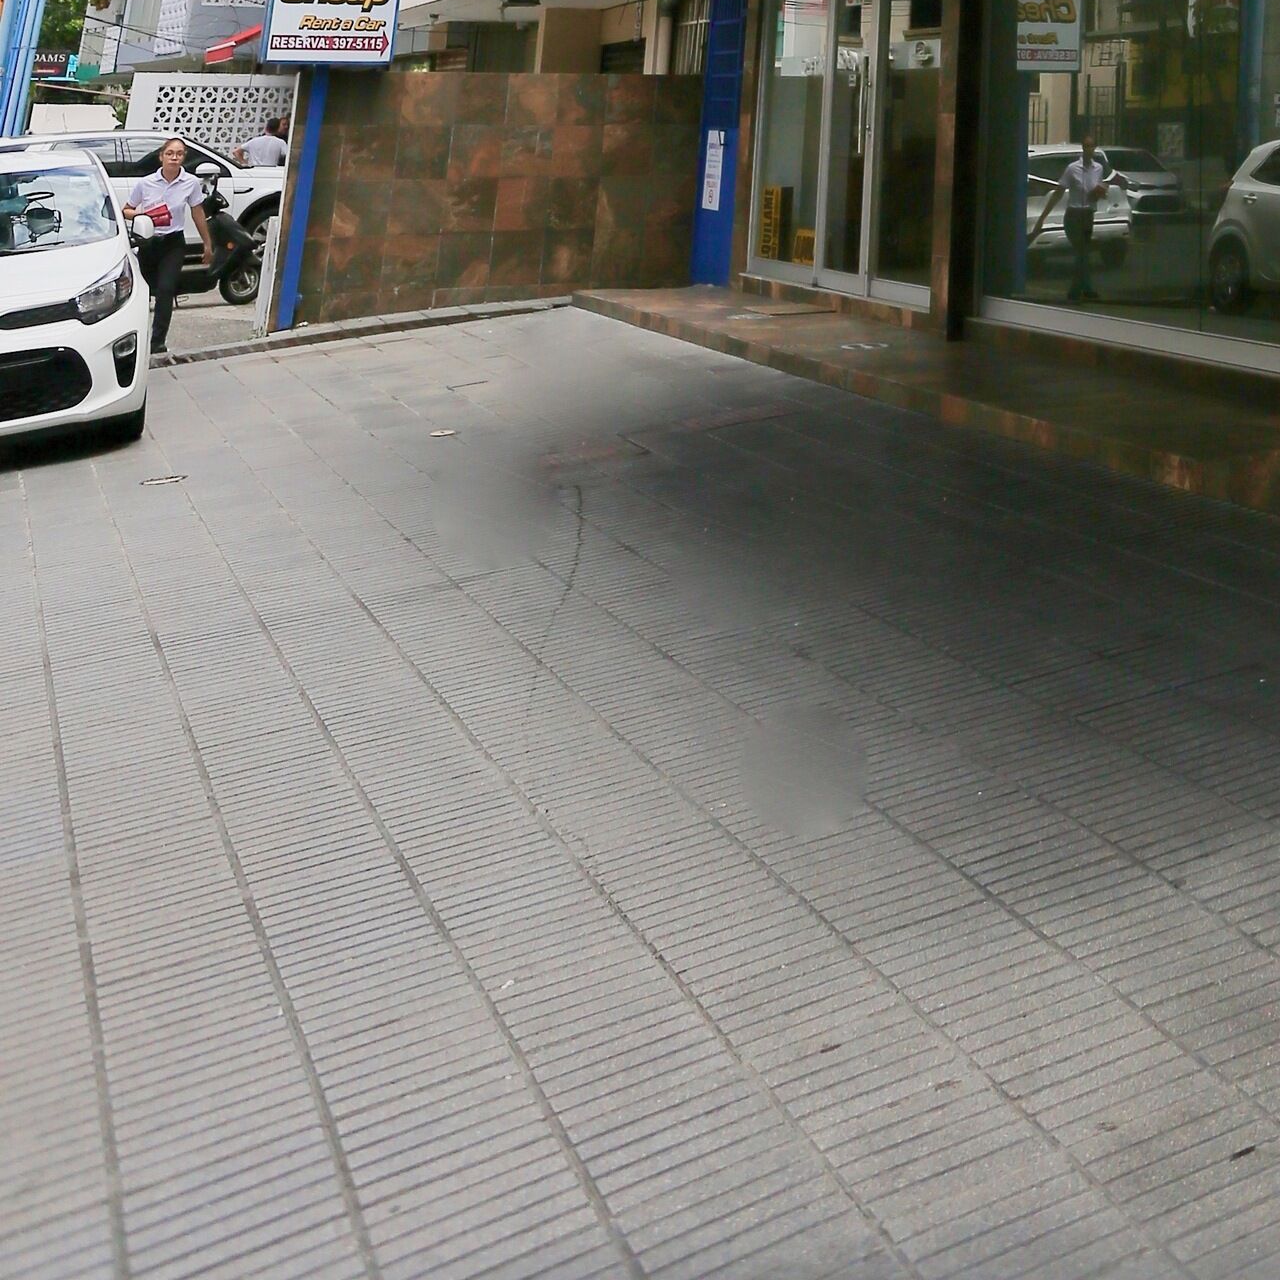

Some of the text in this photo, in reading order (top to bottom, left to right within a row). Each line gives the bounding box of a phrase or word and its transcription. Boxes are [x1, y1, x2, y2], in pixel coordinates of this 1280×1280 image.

[299, 15, 386, 32] Rent a Car
[272, 36, 383, 50] RESERVA: 397-5115
